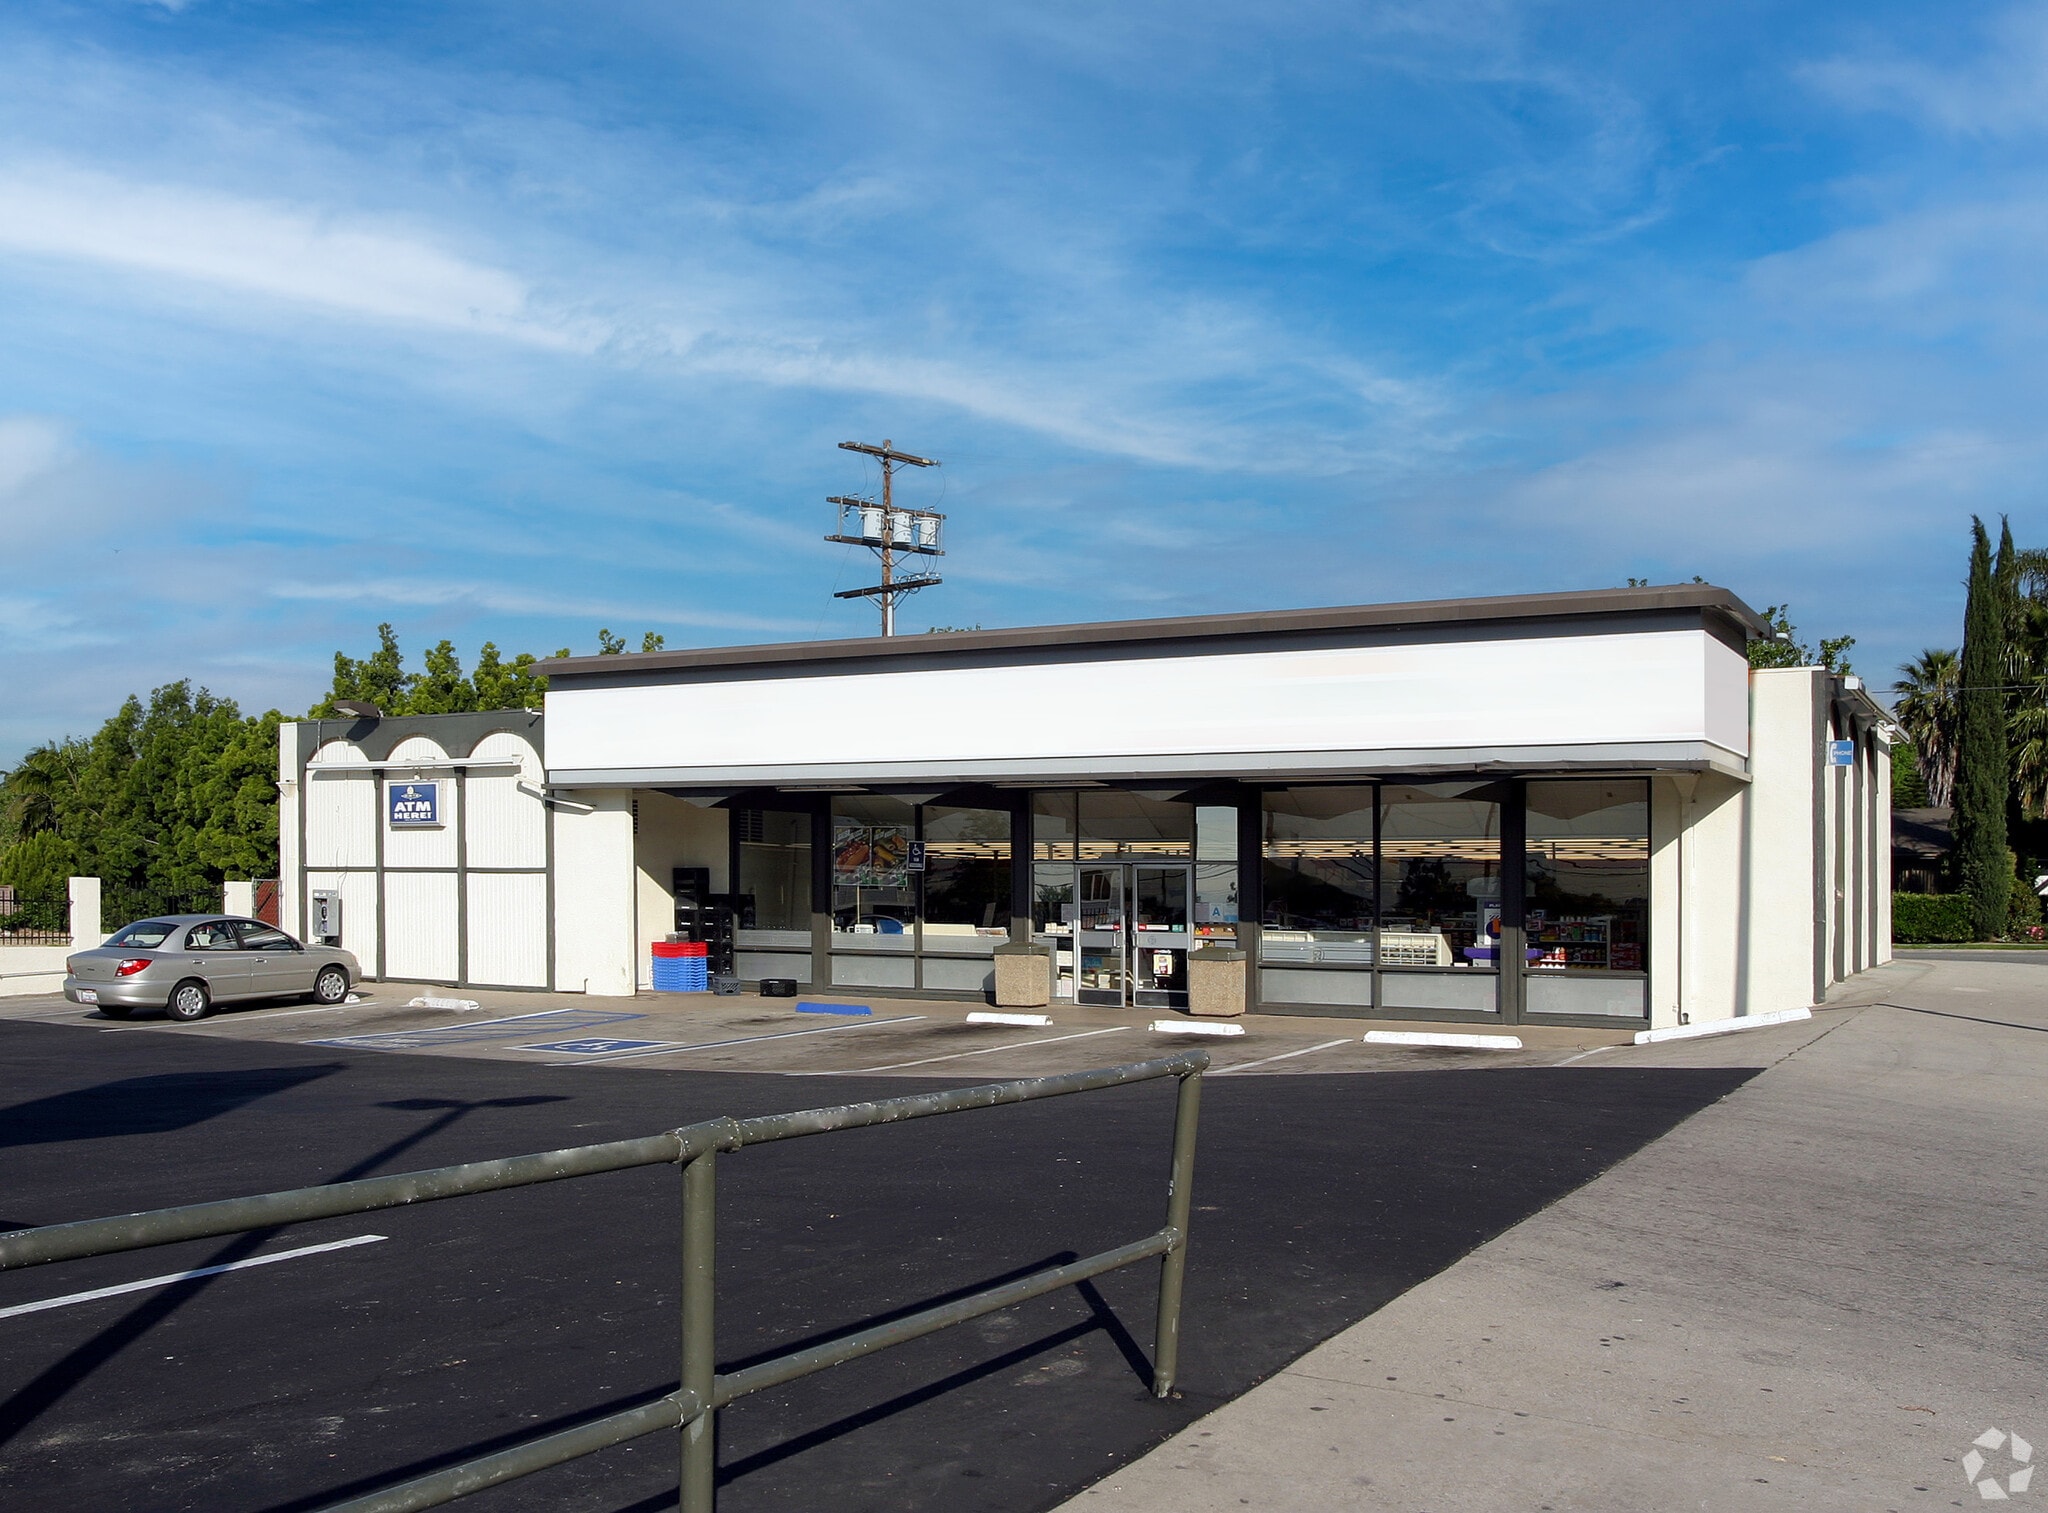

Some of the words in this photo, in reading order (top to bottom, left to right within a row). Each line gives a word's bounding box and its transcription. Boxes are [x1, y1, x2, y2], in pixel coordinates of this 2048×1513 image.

[394, 801, 431, 812] ATM
[393, 811, 432, 820] HERE!
[1212, 906, 1221, 917] A
